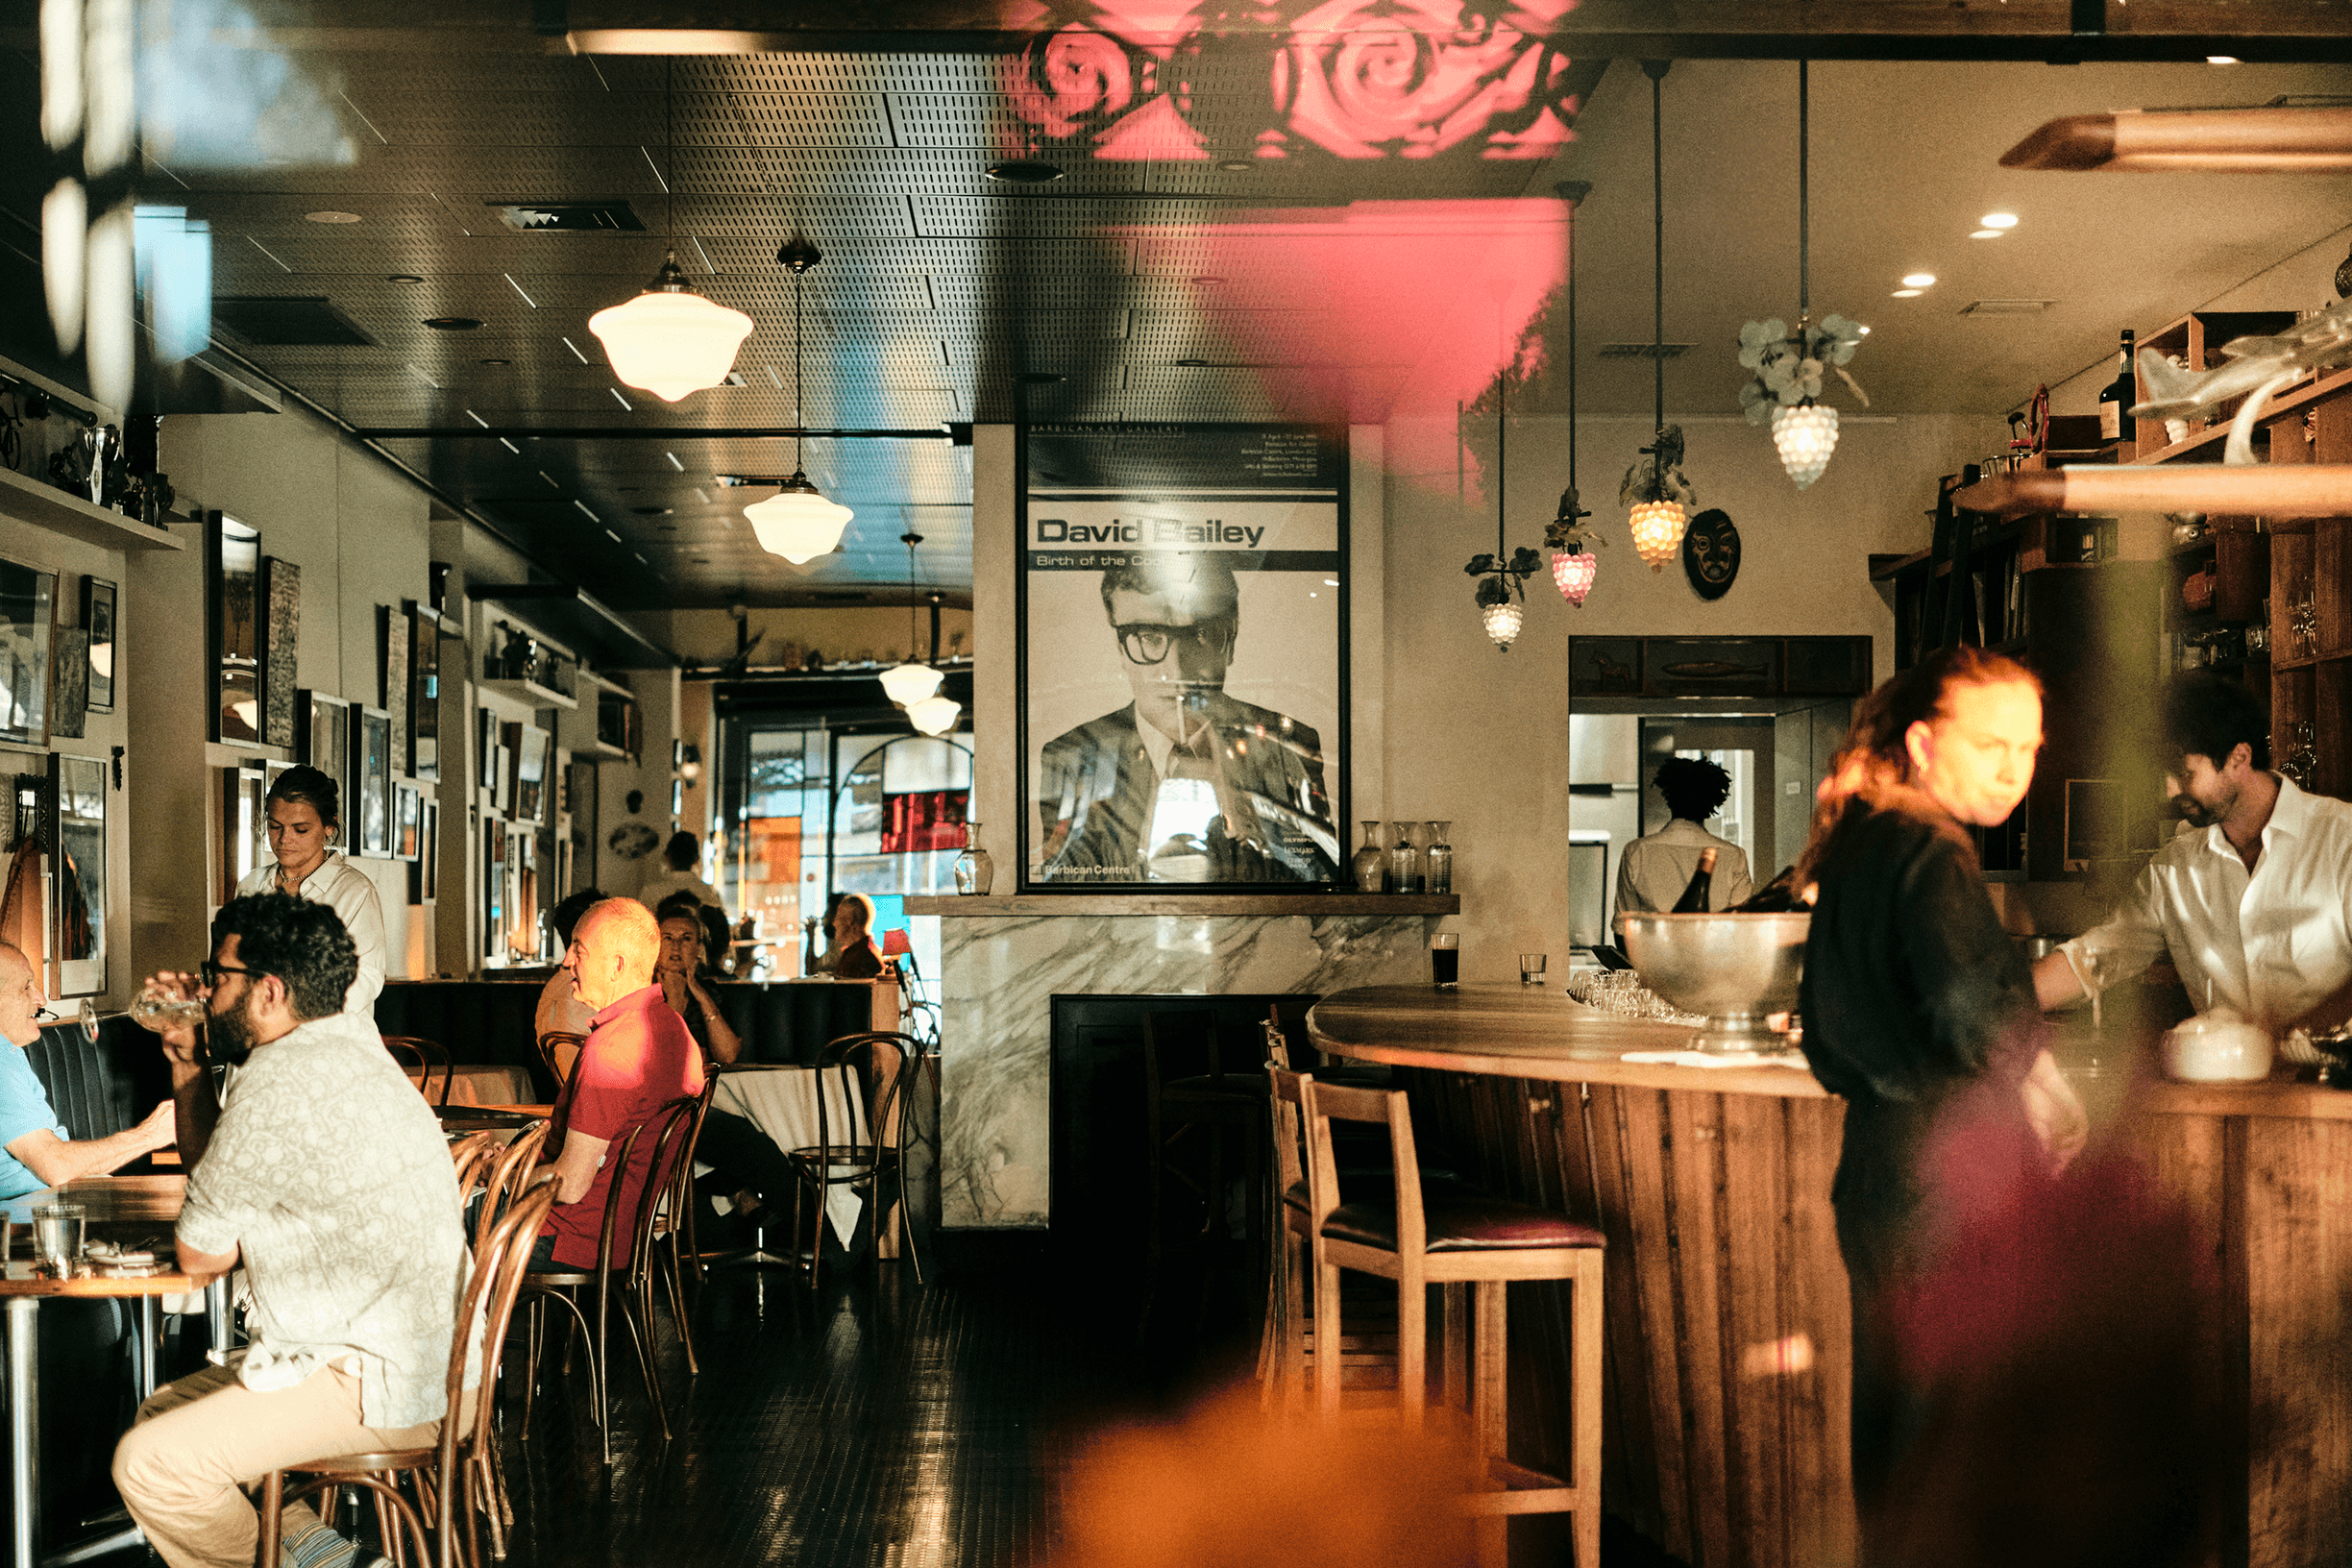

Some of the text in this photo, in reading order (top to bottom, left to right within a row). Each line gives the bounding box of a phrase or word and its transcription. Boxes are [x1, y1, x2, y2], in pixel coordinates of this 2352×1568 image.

[1037, 519, 1143, 543] David
[1036, 555, 1074, 567] Birth
[1079, 555, 1095, 566] of
[1101, 555, 1127, 567] the
[1044, 865, 1131, 874] Barbican Centre
